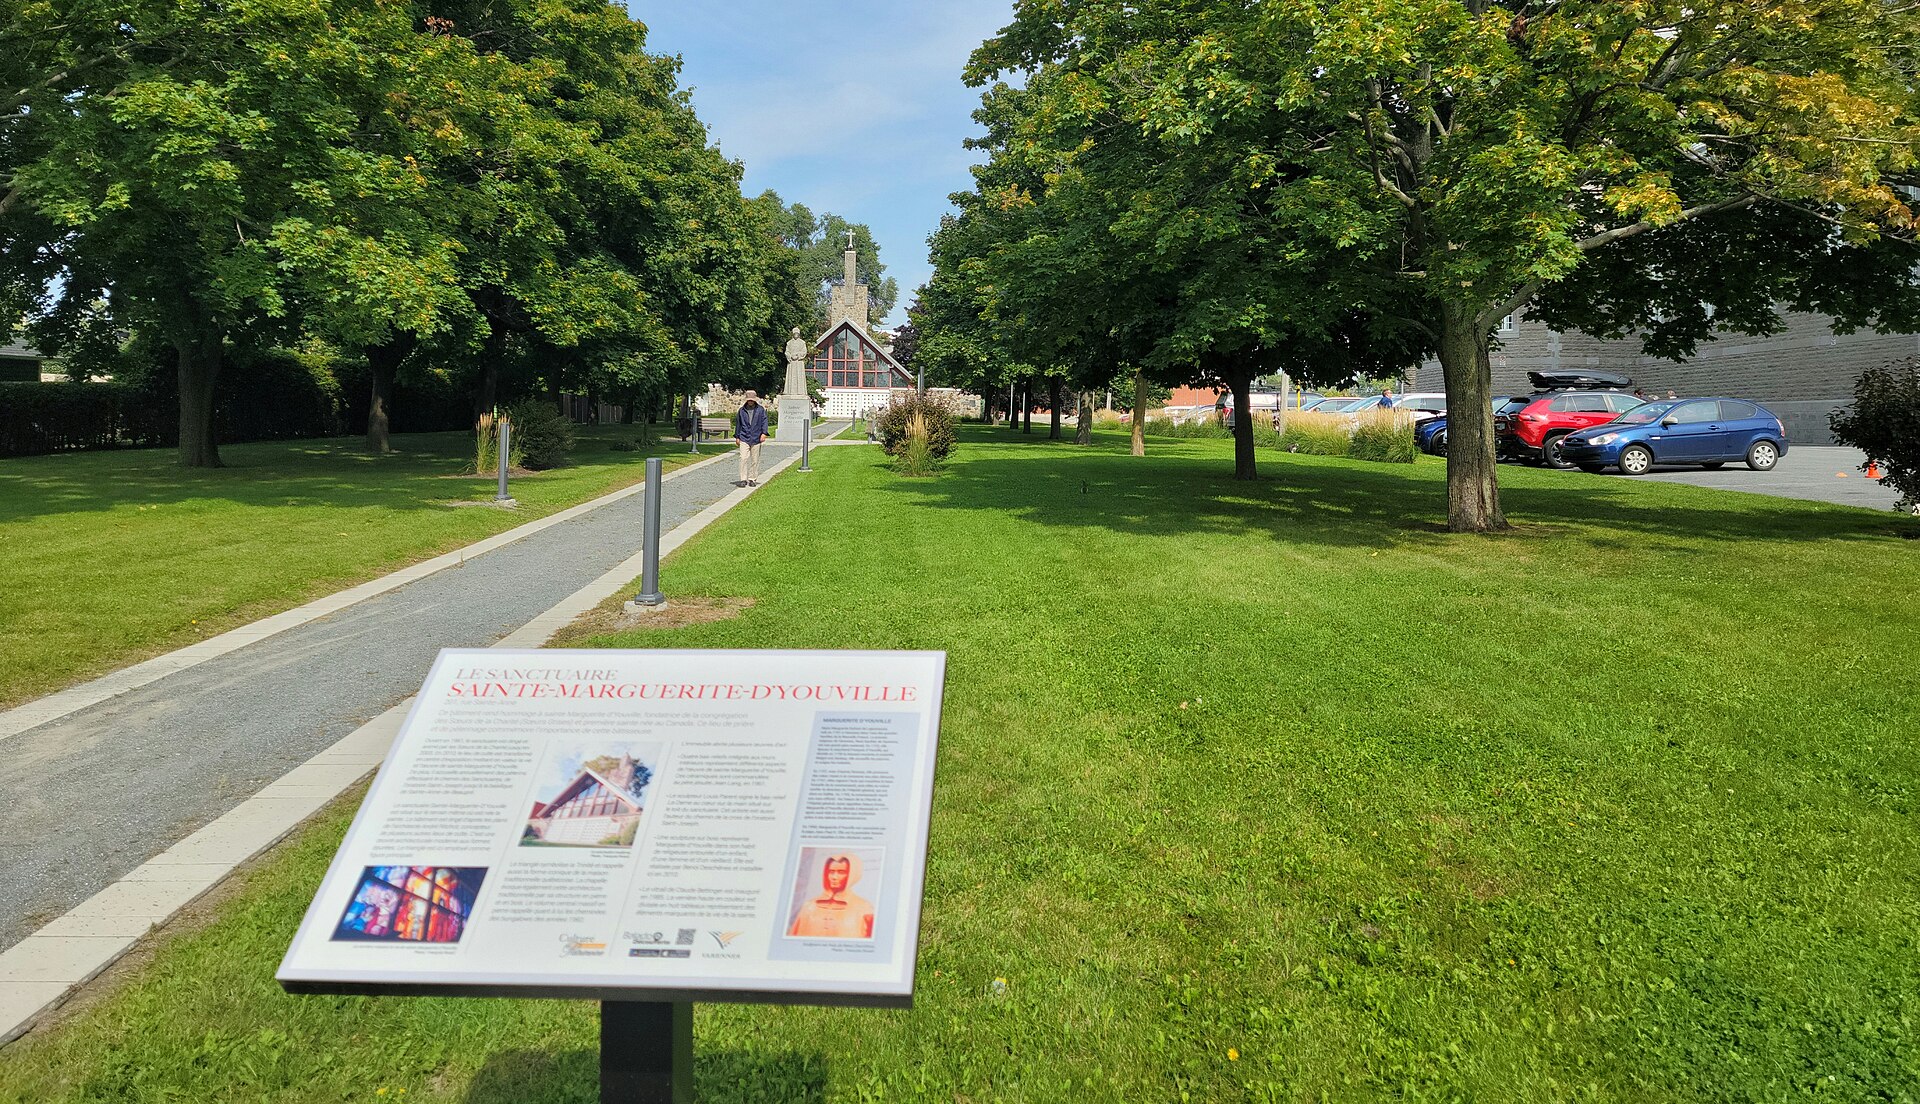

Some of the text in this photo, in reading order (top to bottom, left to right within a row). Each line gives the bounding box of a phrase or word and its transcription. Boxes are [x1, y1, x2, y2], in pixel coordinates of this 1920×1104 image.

[456, 668, 619, 680] LE SANCTUAIRE
[447, 682, 918, 702] SAINTE-MARGUERITE-D'YOUVILLE
